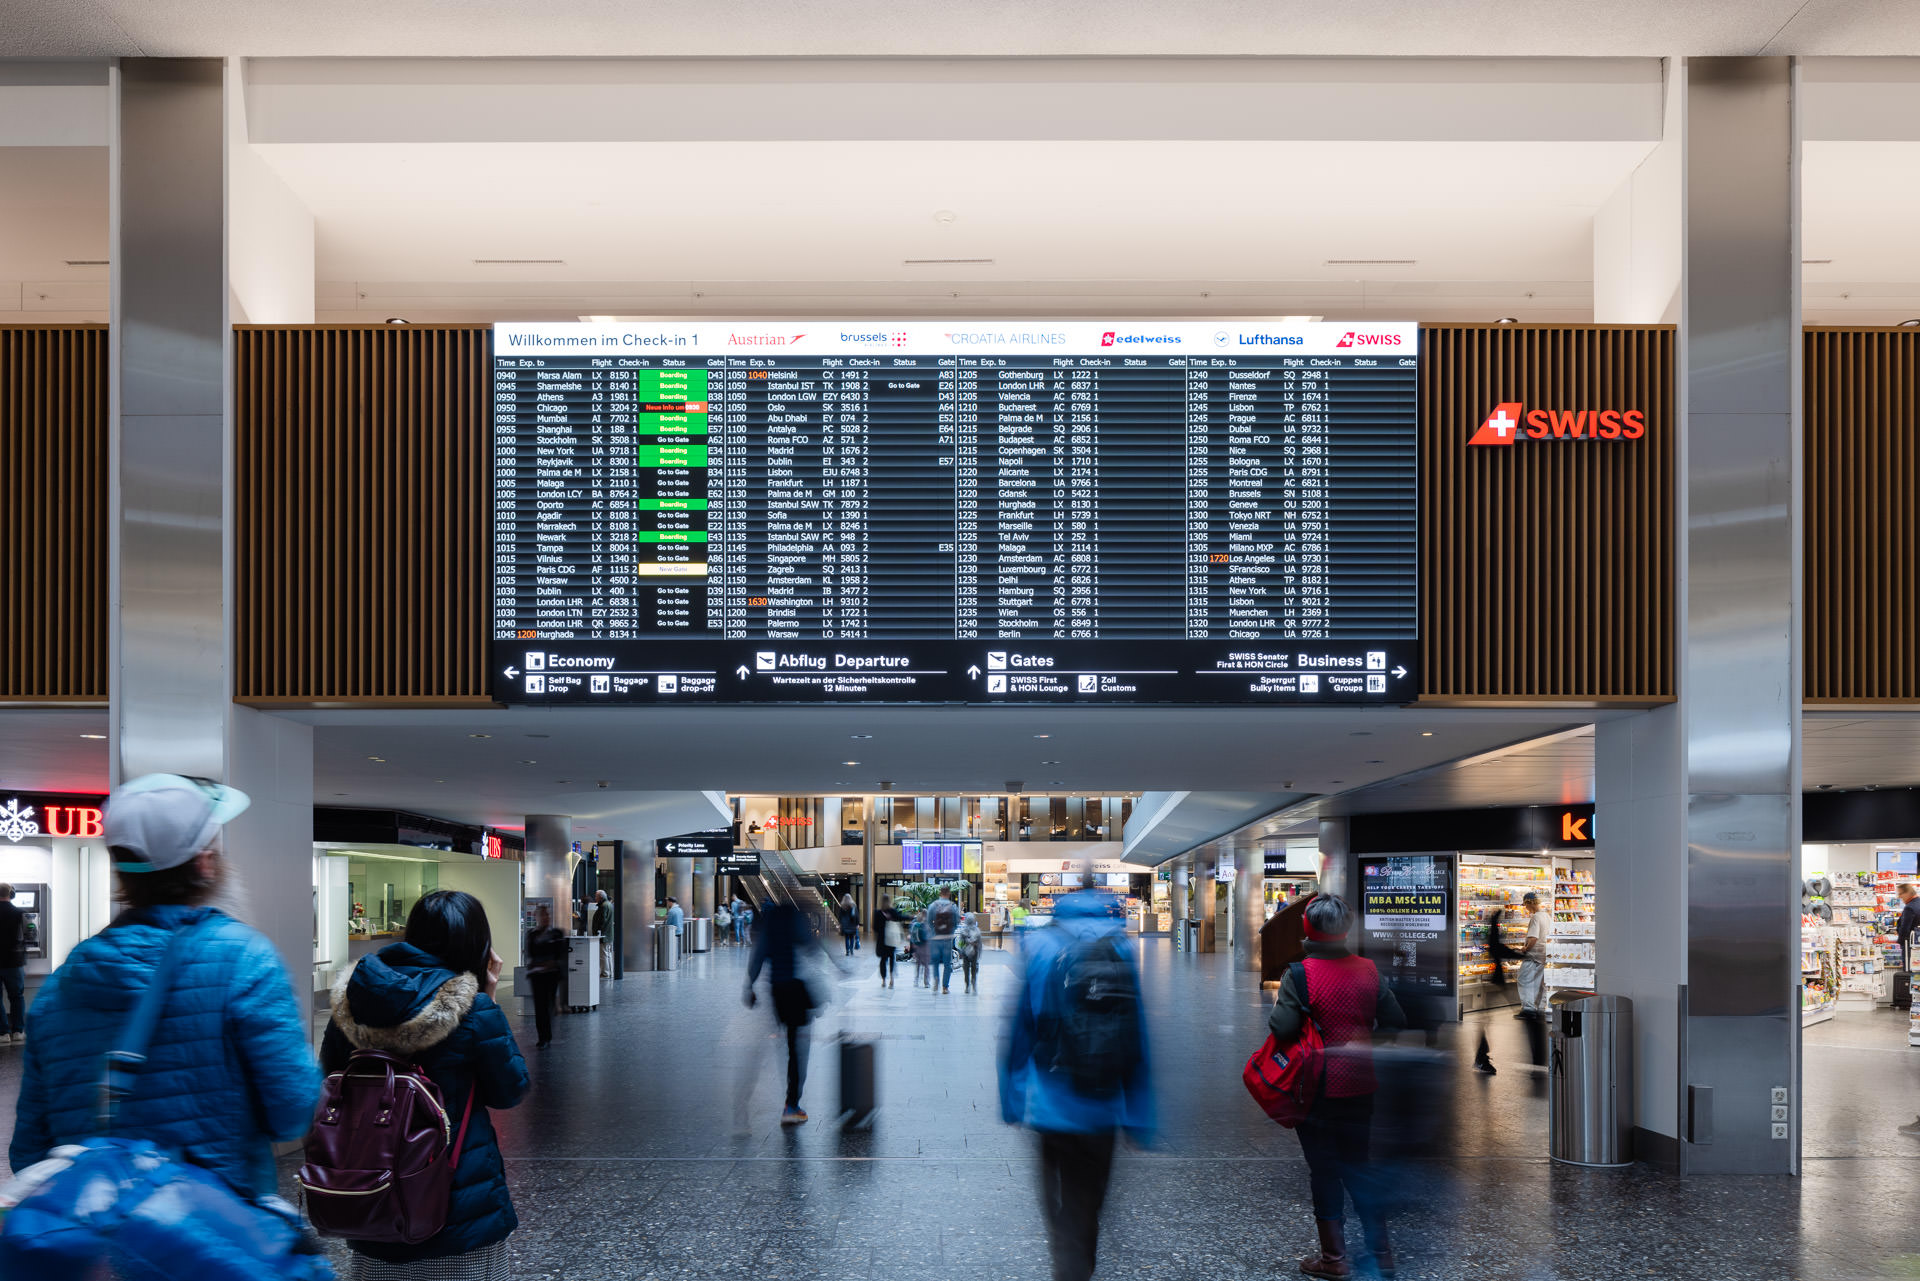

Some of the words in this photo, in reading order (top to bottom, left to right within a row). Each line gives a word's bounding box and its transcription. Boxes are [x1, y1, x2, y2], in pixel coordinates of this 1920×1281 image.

[509, 334, 596, 346] Willkommen
[602, 335, 617, 345] im
[623, 334, 686, 345] Check-in
[692, 334, 697, 345] 1
[728, 333, 785, 345] Austrian
[841, 333, 887, 341] brussels
[951, 334, 1006, 344] CROATIA
[1012, 334, 1065, 344] AIRLINES
[1240, 334, 1303, 345] Lufthansa
[1358, 335, 1401, 345] SWISS
[520, 359, 535, 367] Exp.
[592, 359, 612, 367] Flight
[708, 359, 724, 367] Gate
[610, 371, 629, 380] 8150
[660, 372, 687, 380] Boarding
[708, 371, 723, 379] D43
[728, 371, 746, 379] 1050
[748, 371, 767, 380] 1040
[768, 371, 797, 379] Helsinki
[823, 371, 834, 379] CX
[842, 371, 860, 379] 1491
[939, 371, 954, 379] A83
[959, 371, 977, 379] 1205
[999, 371, 1043, 380] Gothenburg
[1054, 371, 1063, 379] LX
[1072, 371, 1091, 379] 1222
[1189, 371, 1208, 379] 1240
[1229, 371, 1270, 379] Dusseldorf
[1284, 371, 1295, 380] SQ
[1302, 371, 1321, 379] 2948
[1527, 410, 1644, 439] SWISS
[497, 436, 516, 444] 1000
[537, 436, 577, 444] Stockholm
[592, 436, 602, 444] SK
[610, 436, 629, 444] 3508
[708, 436, 723, 444] A62
[728, 544, 746, 552] 1145
[768, 544, 813, 553] Philadelphia
[1244, 555, 1275, 564] Angeles
[497, 566, 515, 574] 1025
[558, 566, 575, 574] CDG
[708, 566, 723, 574] A63
[959, 565, 977, 573] 1230
[999, 565, 1046, 575] Luxembourg
[1054, 565, 1064, 573] AC
[1071, 565, 1091, 573] 6772
[728, 598, 746, 606] 1155
[748, 598, 767, 606] 1630
[768, 598, 813, 607] Washington
[823, 598, 833, 606] LH
[518, 630, 536, 640] 1200
[537, 630, 574, 640] Hurghada
[609, 630, 629, 638] 8134
[959, 630, 977, 638] 1240
[999, 630, 1020, 638] Berlin
[1054, 630, 1065, 639] AC
[1071, 630, 1091, 638] 6766
[1189, 630, 1208, 638] 1320
[1229, 630, 1260, 639] Chicago
[1284, 630, 1296, 639] UA
[1302, 630, 1321, 639] 9726
[549, 654, 615, 669] Economy
[779, 654, 826, 669] Abflug
[836, 654, 909, 669] Departure
[1011, 654, 1054, 666] Gates
[1298, 654, 1363, 666] Business
[566, 677, 581, 685] Bag
[614, 677, 648, 685] Baggage
[681, 677, 715, 685] Baggage
[1261, 677, 1295, 685] Sperrgut
[549, 685, 568, 693] Drop
[614, 685, 628, 693] Tag
[681, 683, 714, 693] drop-off
[1039, 685, 1068, 693] Lounge
[1334, 684, 1363, 692] Groups
[45, 807, 104, 837] UB
[779, 817, 813, 826] SWISS
[489, 836, 502, 858] UBS
